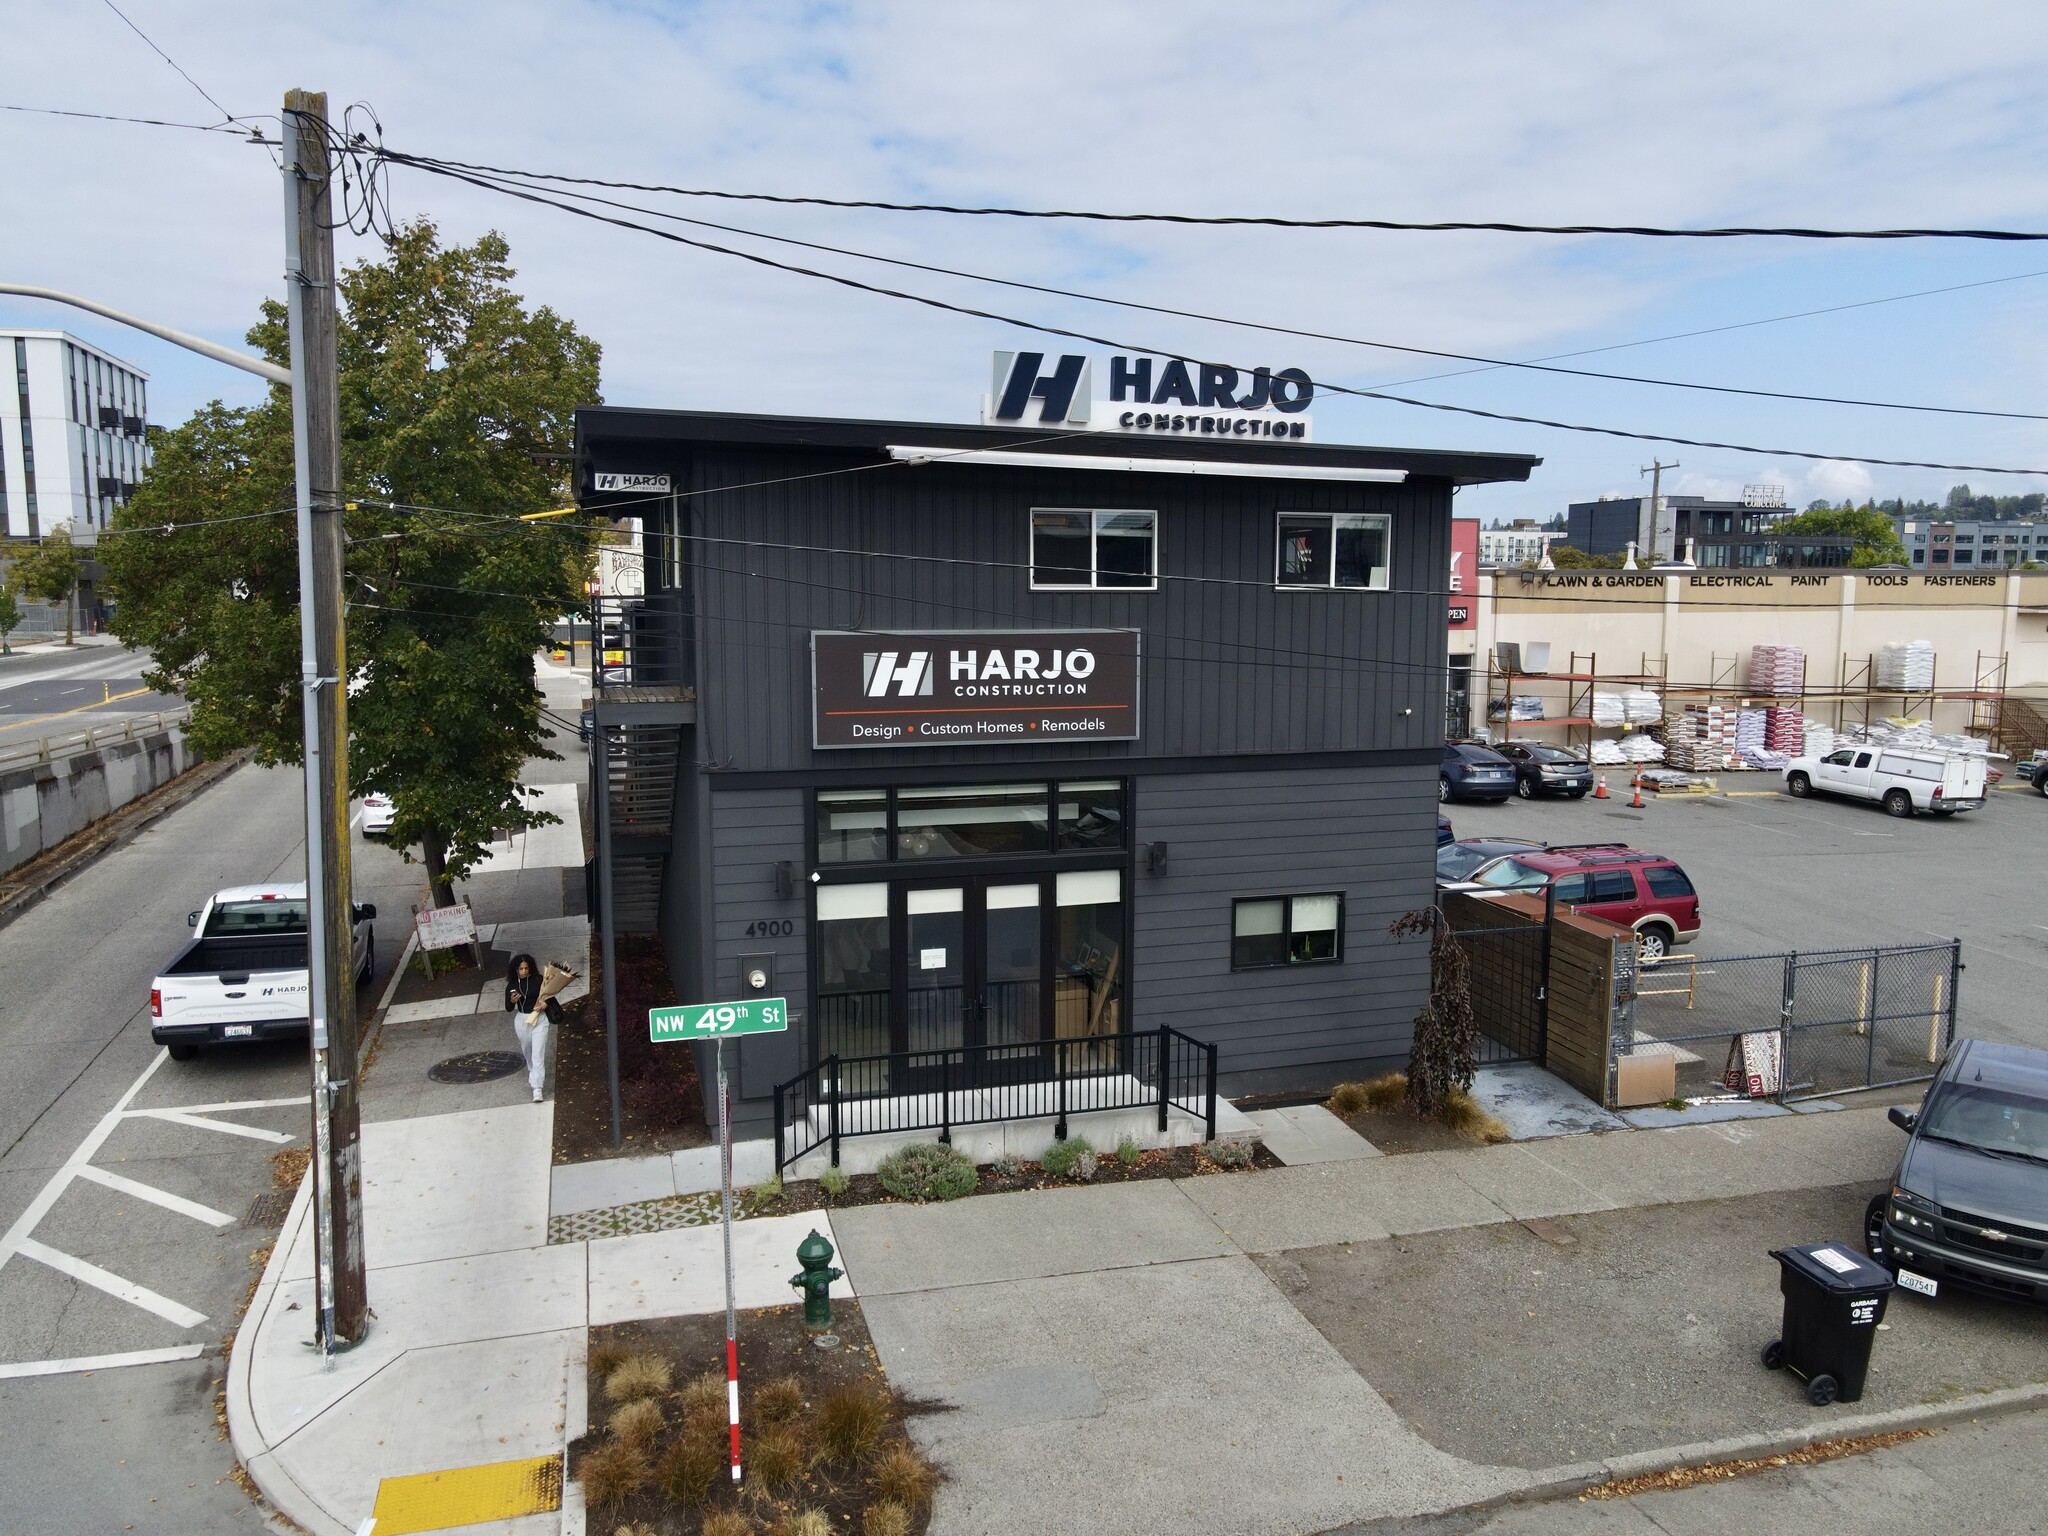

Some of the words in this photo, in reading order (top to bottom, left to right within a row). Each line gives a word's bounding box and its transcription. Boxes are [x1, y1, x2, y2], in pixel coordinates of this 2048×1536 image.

[1110, 355, 1315, 414] HARJO
[1119, 411, 1306, 438] CONSTRUCTION
[623, 476, 668, 486] HARJO
[1547, 576, 1588, 588] LAWN
[1592, 577, 1603, 588] &
[1606, 576, 1664, 588] GARDEN
[1690, 576, 1773, 588] ELECTRICAL
[1791, 575, 1830, 587] PAINT
[1866, 575, 1909, 587] TOOLS
[1924, 576, 1997, 587] FASTENERS
[1448, 608, 1467, 620] PEN
[949, 647, 1096, 681] HARJO
[954, 683, 1087, 698] CONSTRUCTION
[852, 724, 902, 740] Design
[920, 721, 973, 736] Custom
[977, 720, 1025, 734] Homes
[1041, 717, 1106, 732] Remodels
[432, 907, 467, 920] PARKING
[745, 919, 794, 938] 4900
[277, 985, 308, 993] HARJO
[655, 1014, 685, 1034] NW
[695, 1006, 749, 1033] 49th
[762, 1006, 781, 1025] St
[1750, 1077, 1762, 1094] NO
[1899, 1274, 1934, 1294] C20754T
[1851, 1299, 1879, 1308] GARBAGE
